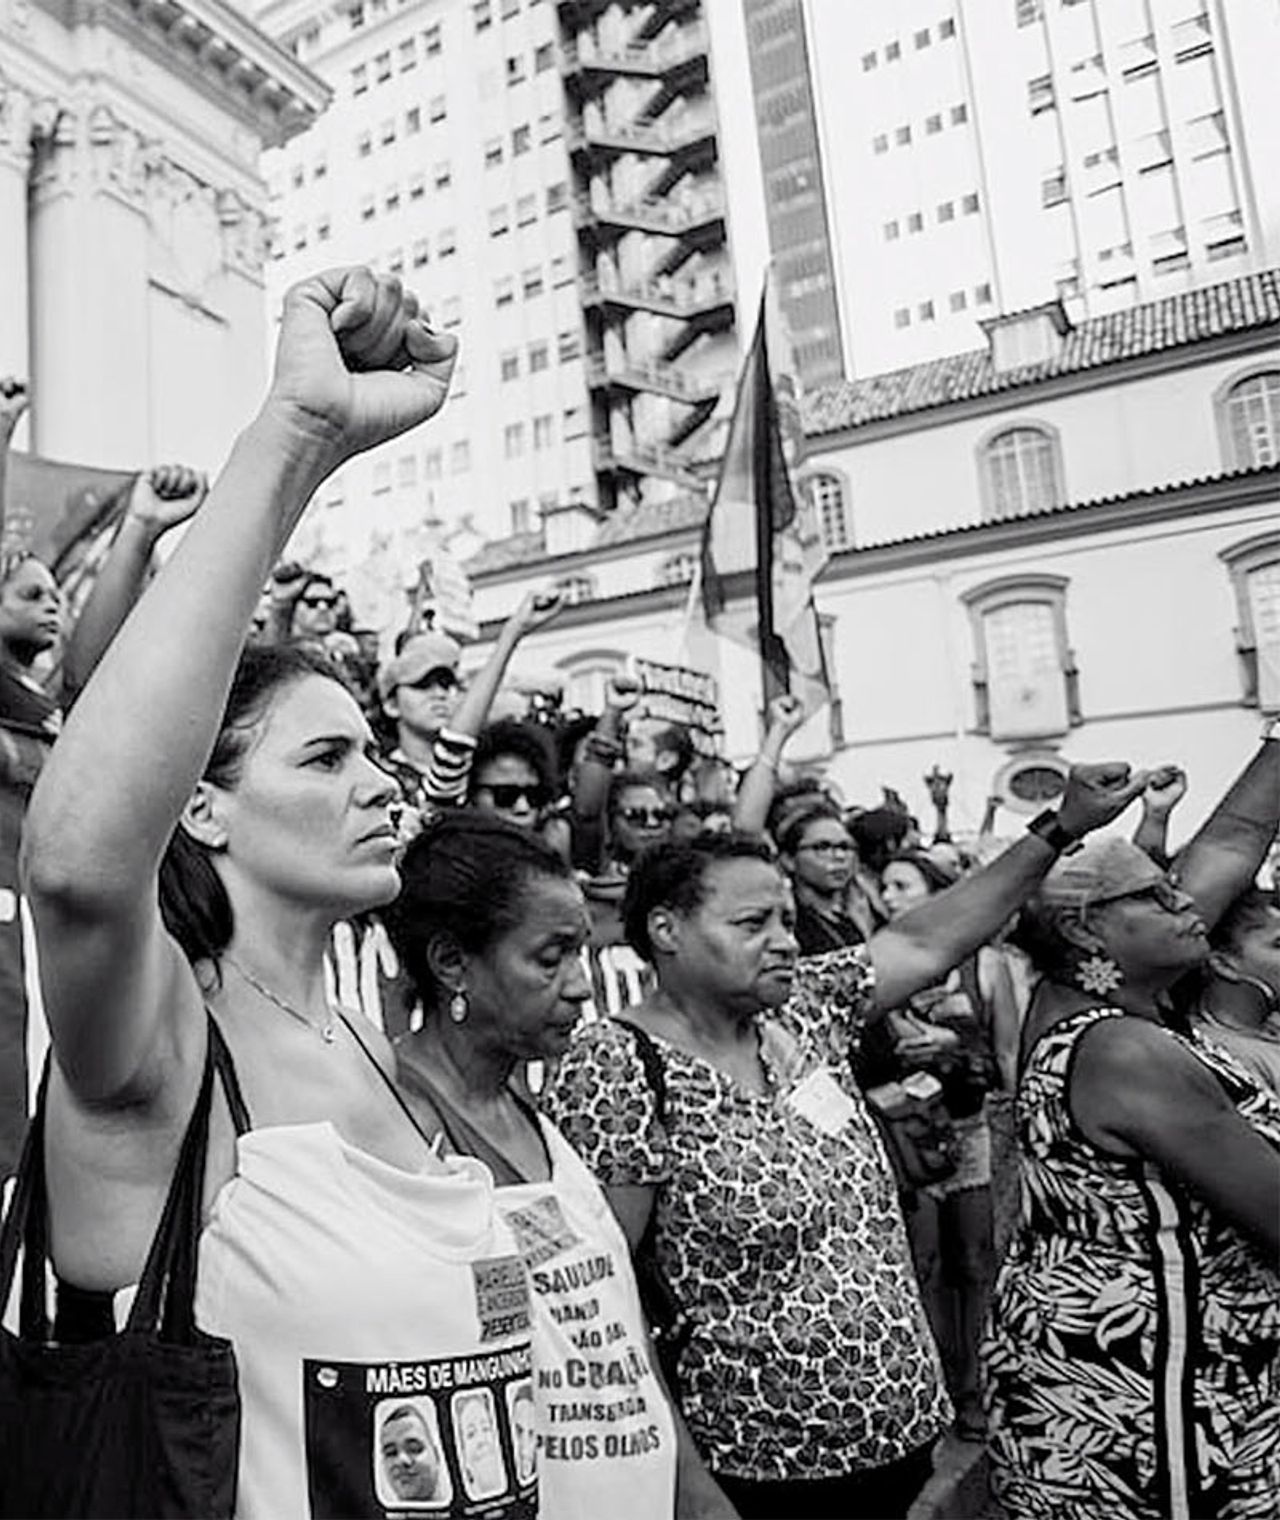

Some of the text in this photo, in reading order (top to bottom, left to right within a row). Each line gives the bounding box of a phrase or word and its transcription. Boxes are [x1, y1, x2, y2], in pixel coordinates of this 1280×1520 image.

[366, 1363, 426, 1393] MÃES
[429, 1363, 453, 1390] DE
[538, 1369, 562, 1389] NO
